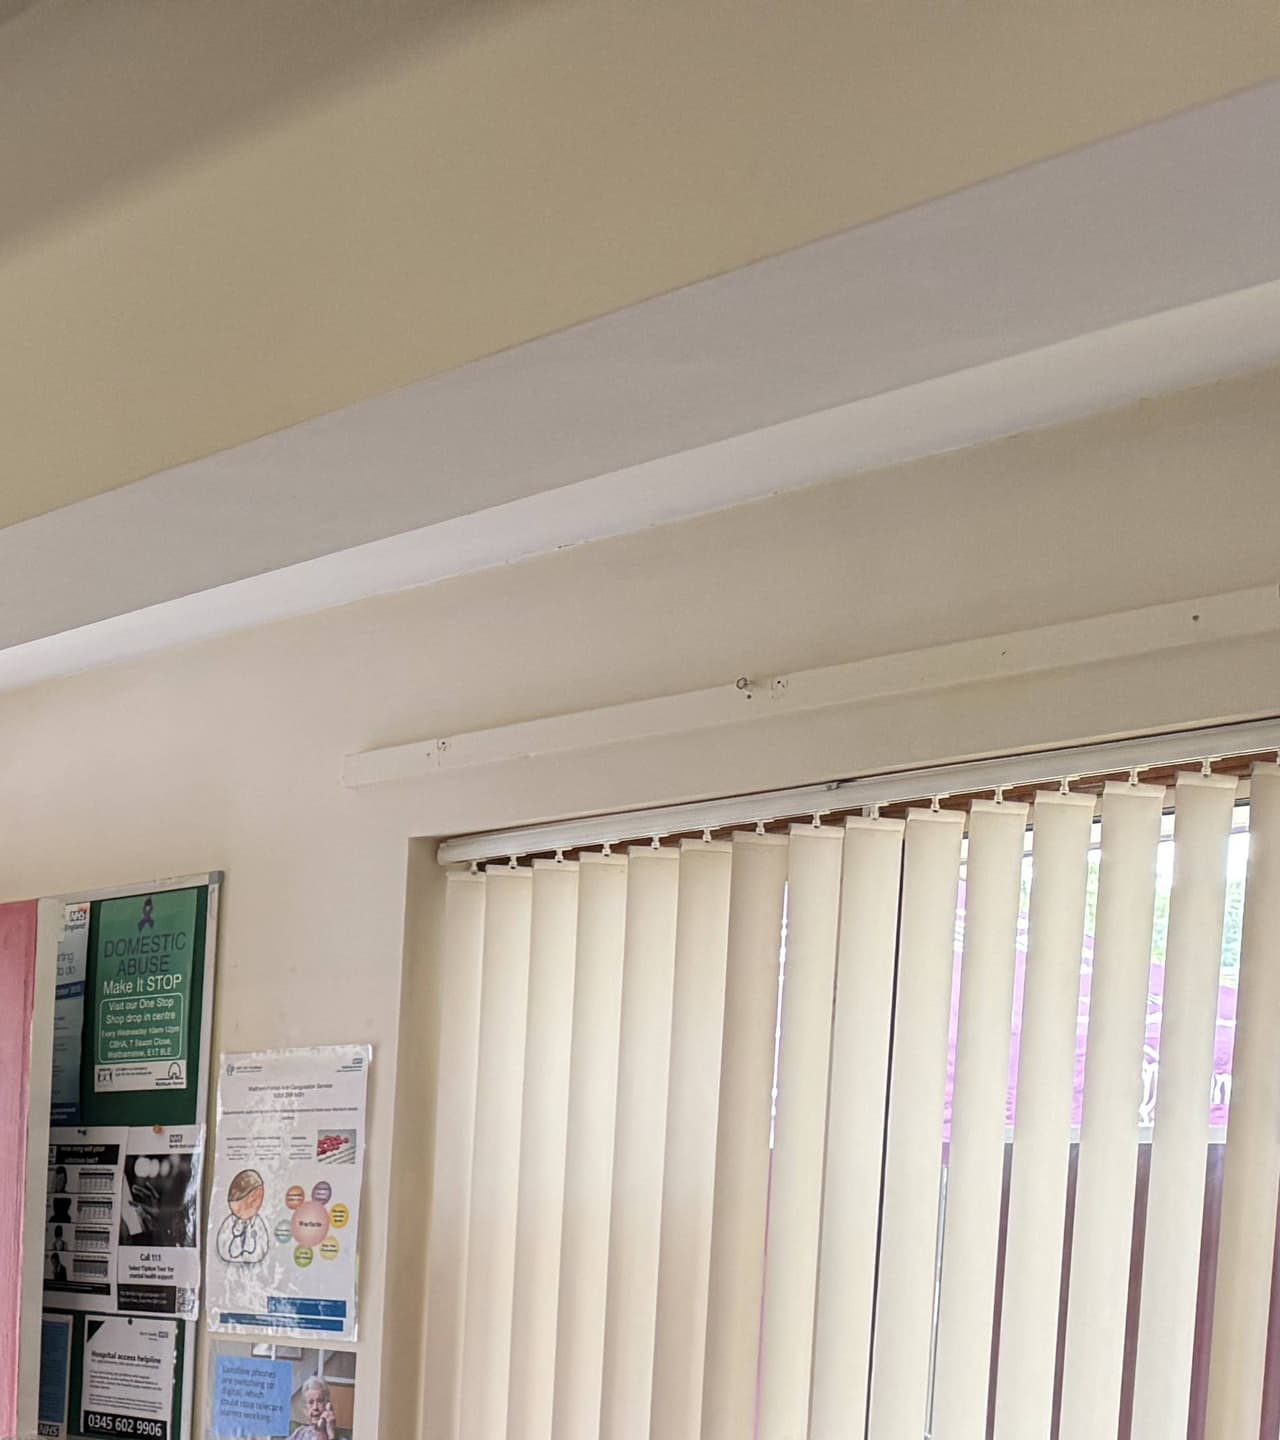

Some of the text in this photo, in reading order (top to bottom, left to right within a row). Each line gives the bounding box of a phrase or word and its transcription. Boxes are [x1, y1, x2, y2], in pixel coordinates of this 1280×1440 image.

[104, 932, 187, 958] DOMESTIC
[117, 955, 171, 977] ABUSE
[104, 974, 183, 995] Make It STOP
[109, 998, 174, 1010] Visit our One Stop
[106, 1011, 176, 1025] Shop drop in centre
[140, 1253, 150, 1261] Call
[91, 1350, 116, 1360] Hospital
[137, 1355, 161, 1364] helpline
[40, 1424, 58, 1436] NHS
[88, 1414, 163, 1437] 0345 602 9906
